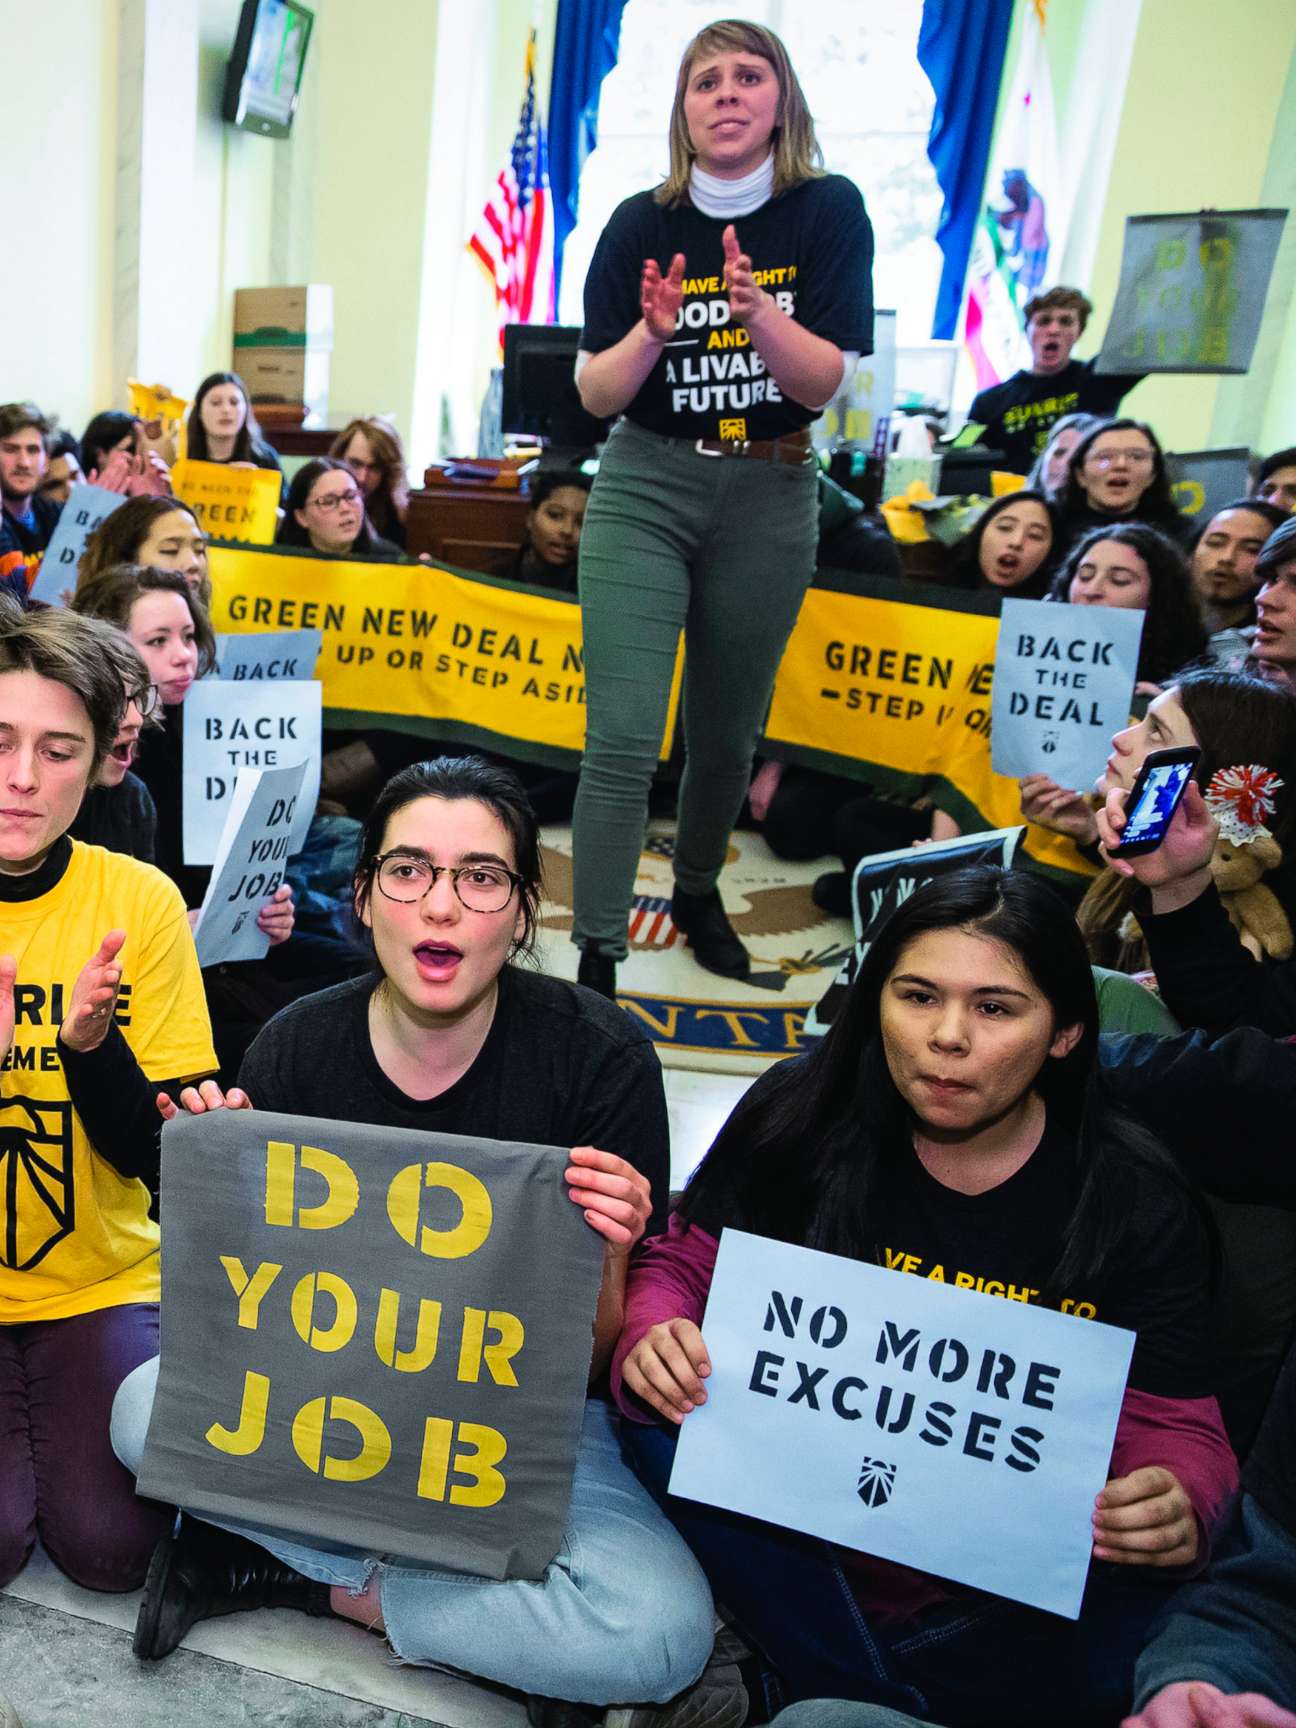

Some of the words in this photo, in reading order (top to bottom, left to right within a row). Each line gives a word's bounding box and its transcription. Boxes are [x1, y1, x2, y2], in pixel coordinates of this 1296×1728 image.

[707, 327, 751, 350] AND
[672, 378, 783, 413] FUTURE
[193, 503, 256, 523] REEN
[228, 595, 345, 632] GREEN
[362, 607, 438, 638] NEW
[452, 622, 544, 667] DEAL
[824, 641, 953, 690] GREEN
[1016, 634, 1115, 666] BACK
[233, 658, 299, 681] BACK
[336, 645, 375, 665] UP
[387, 649, 423, 672] OR
[437, 655, 508, 689] STEP
[1035, 669, 1088, 690] THE
[1009, 692, 1105, 727] DEAL
[205, 717, 297, 741] BACK
[227, 750, 278, 766] THE
[248, 837, 289, 863] YOU
[227, 872, 282, 902] JOB
[264, 1140, 494, 1260] DO
[927, 1264, 945, 1283] A
[219, 1255, 526, 1388] YOUR
[763, 1290, 848, 1349] NO
[875, 1320, 1062, 1412] MORE
[748, 1350, 1045, 1474] EXCUSES
[205, 1369, 508, 1509] JOB
